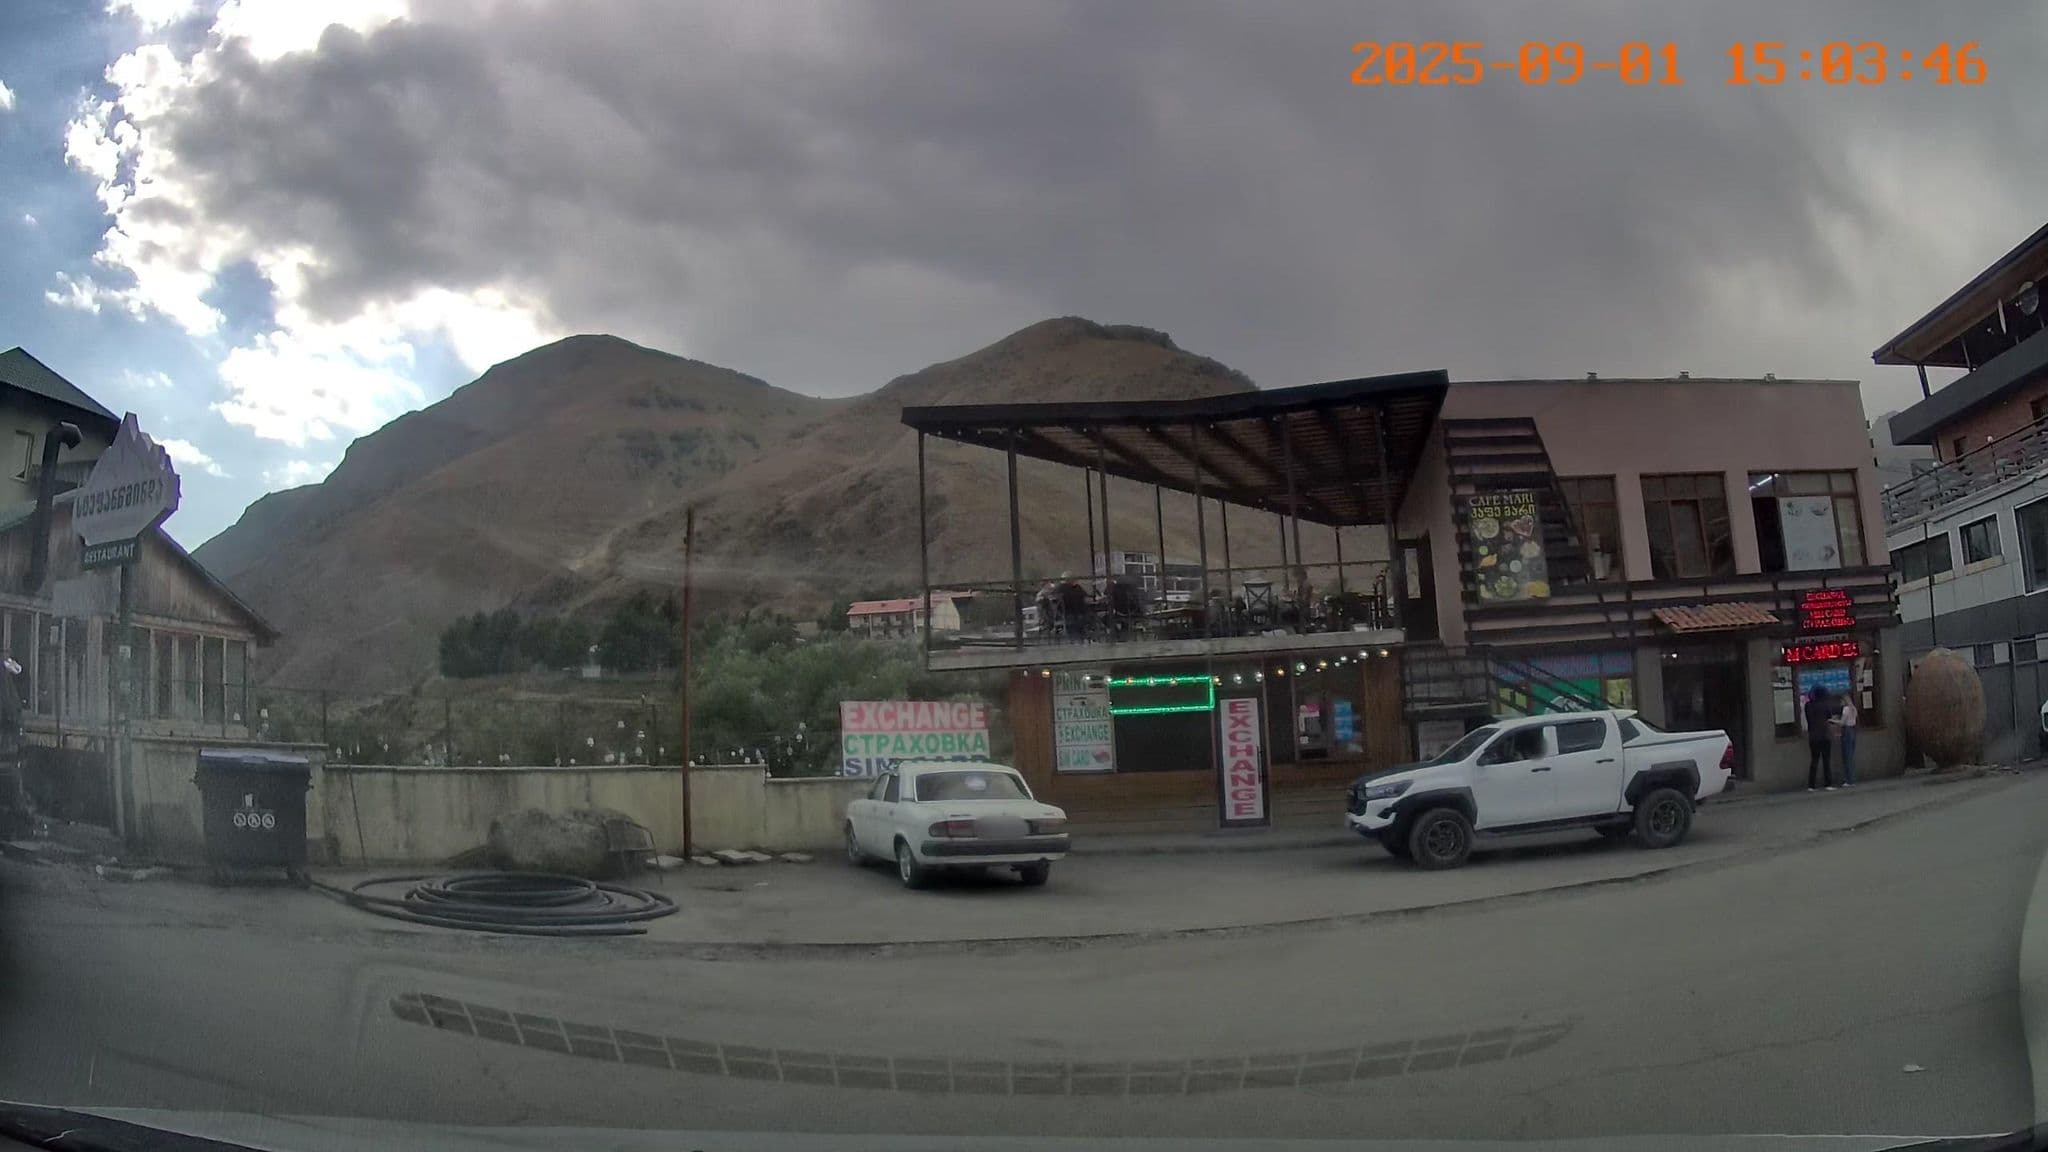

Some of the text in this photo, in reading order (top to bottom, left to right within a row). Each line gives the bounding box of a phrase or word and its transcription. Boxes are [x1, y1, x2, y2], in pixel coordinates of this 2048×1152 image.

[1469, 492, 1534, 507] CAFE MARI
[84, 544, 136, 563] RESTAURANT
[844, 702, 986, 730] EXCHANGE
[844, 732, 987, 755] СТРАХОВКА
[1228, 700, 1257, 817] EXCHANGE
